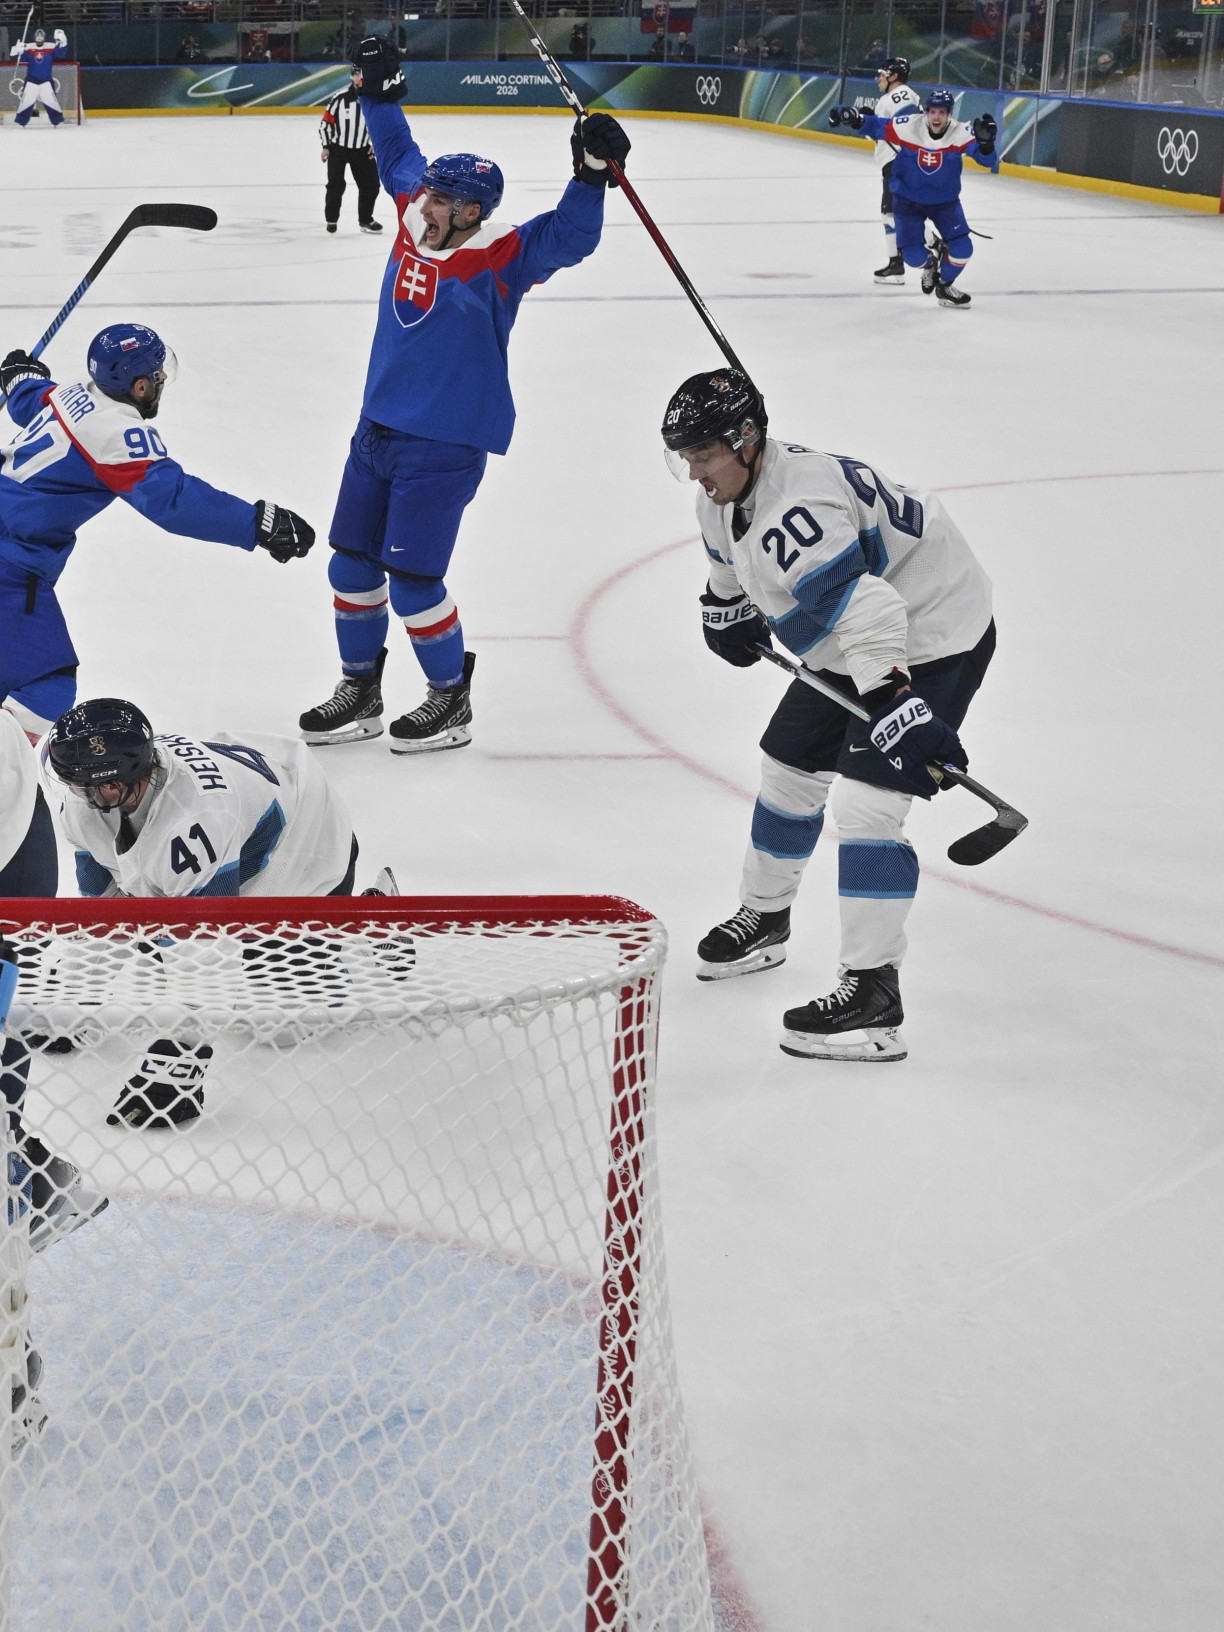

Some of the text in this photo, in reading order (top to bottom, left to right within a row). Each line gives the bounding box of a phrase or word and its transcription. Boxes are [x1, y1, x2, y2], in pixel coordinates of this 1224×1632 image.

[460, 75, 553, 85] MILANO CORTINA
[496, 86, 518, 95] 2026
[891, 90, 911, 104] 62
[666, 408, 681, 424] 20
[123, 426, 167, 460] 90
[761, 505, 824, 573] 20
[701, 603, 753, 624] BAUE
[354, 698, 384, 720] CCM
[91, 769, 118, 779] CCM
[170, 822, 217, 875] 41
